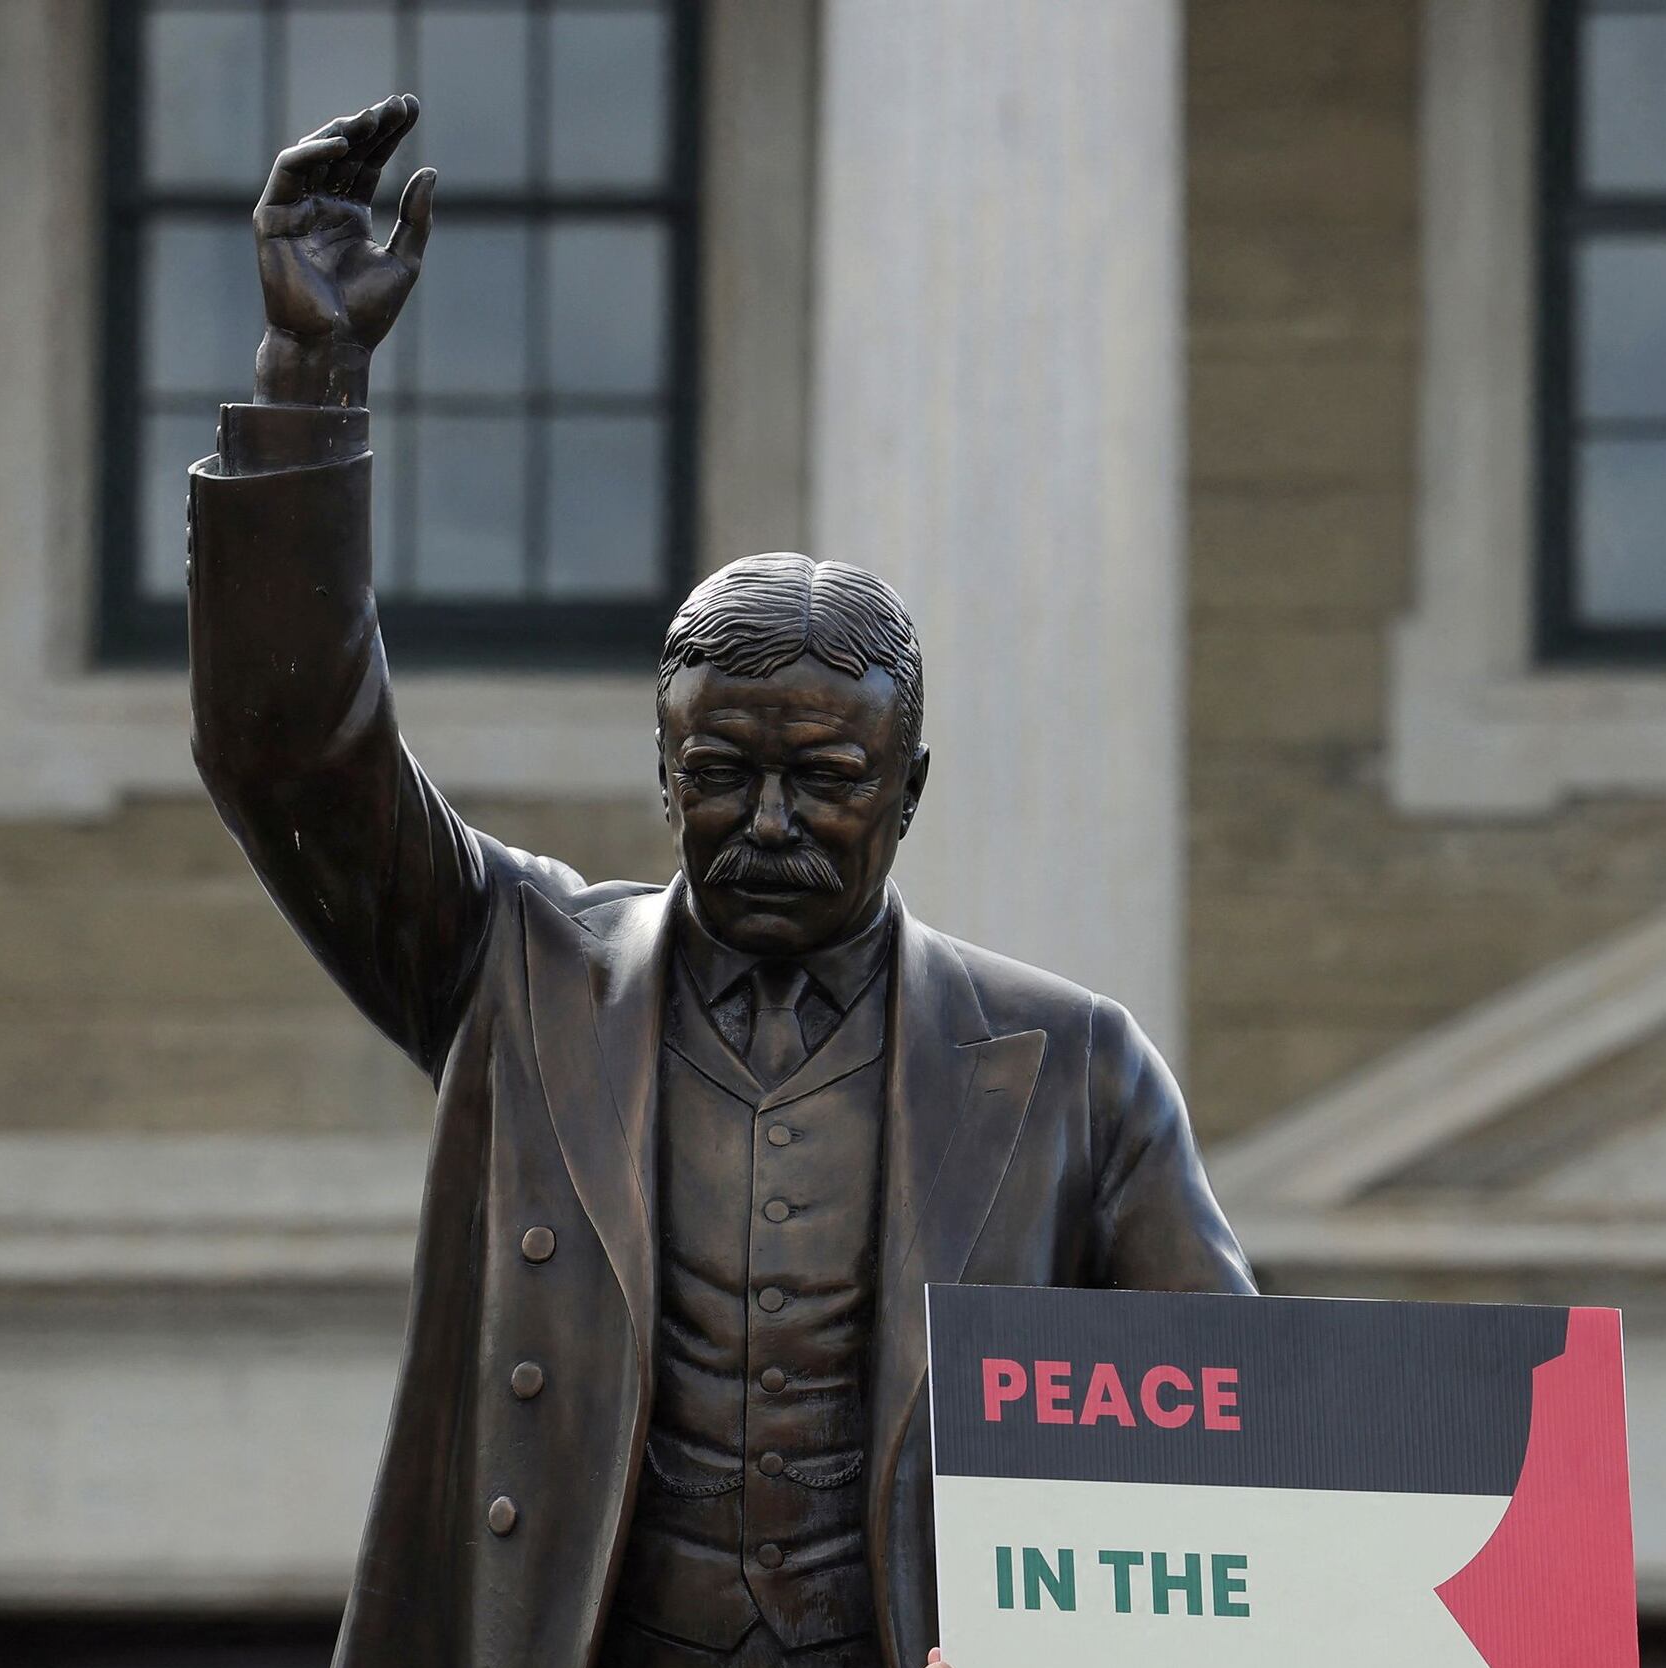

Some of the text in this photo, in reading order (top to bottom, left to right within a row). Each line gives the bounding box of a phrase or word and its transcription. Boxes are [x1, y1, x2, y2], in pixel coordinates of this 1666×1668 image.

[984, 1359, 1241, 1430] PEACE
[996, 1547, 1249, 1617] IN THE
